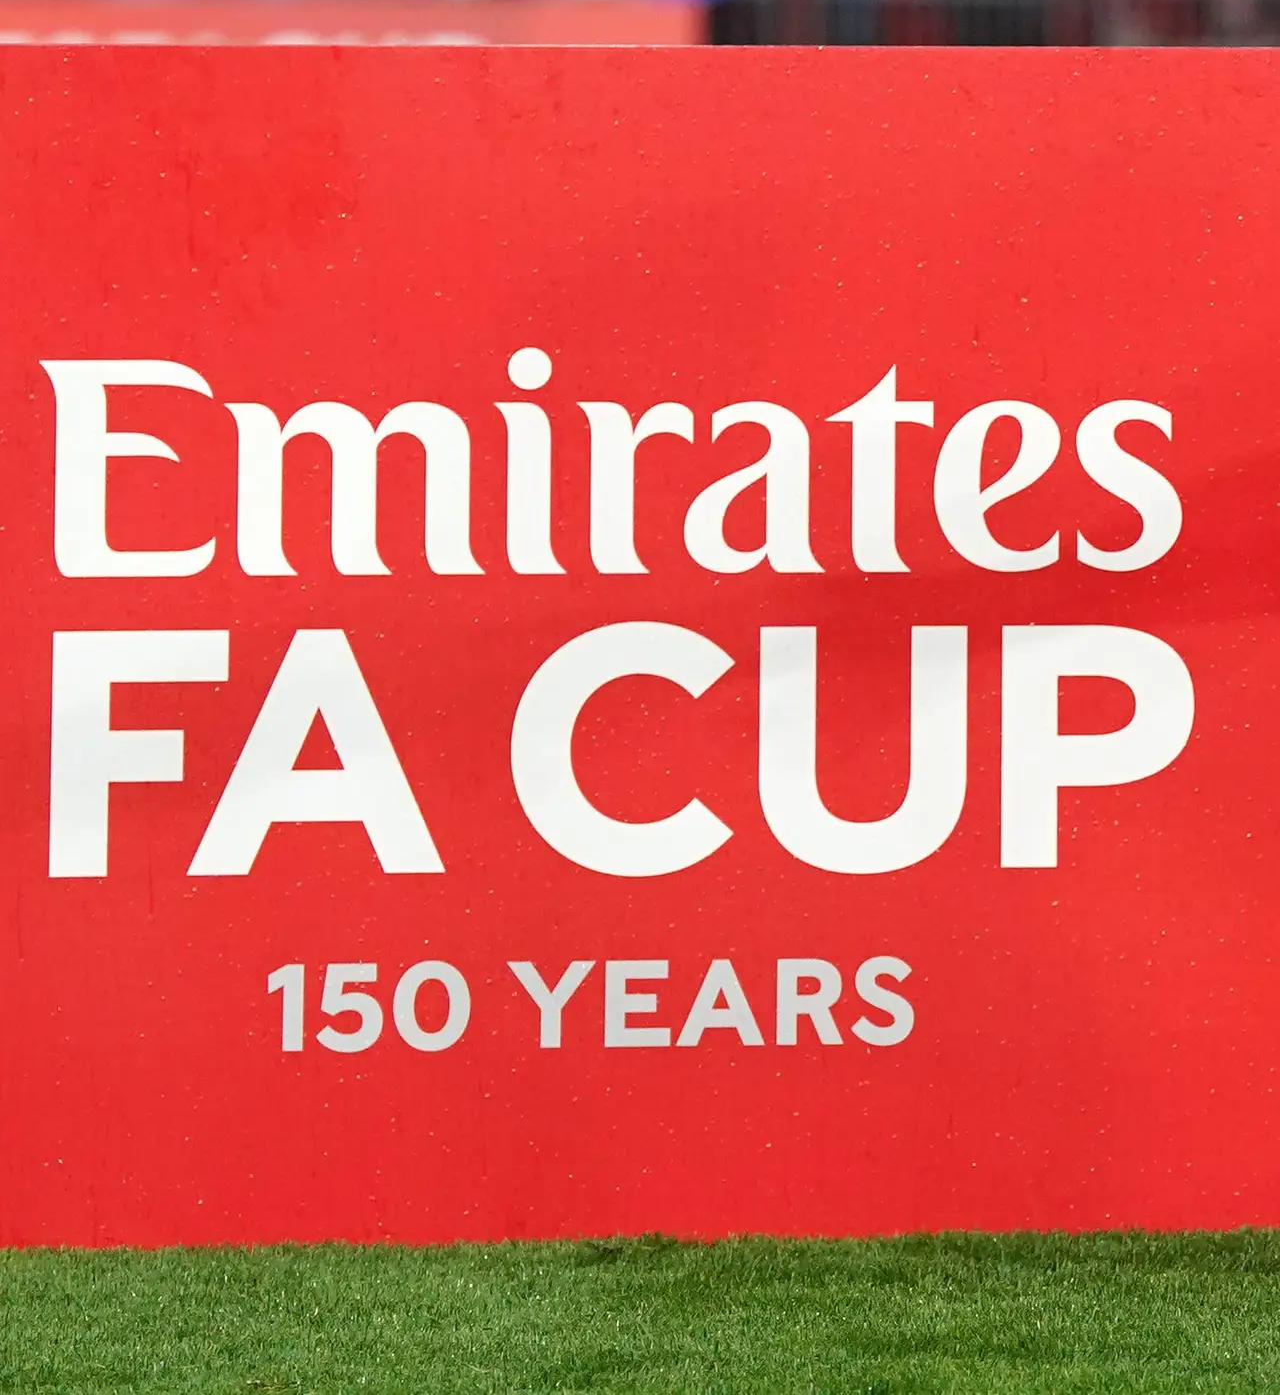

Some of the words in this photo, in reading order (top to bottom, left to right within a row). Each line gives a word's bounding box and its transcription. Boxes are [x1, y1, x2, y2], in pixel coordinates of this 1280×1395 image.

[39, 347, 1184, 578] Emirates
[48, 628, 446, 878] FA
[510, 621, 1195, 878] CUP
[266, 961, 471, 1053] 150
[508, 956, 916, 1049] YEARS
